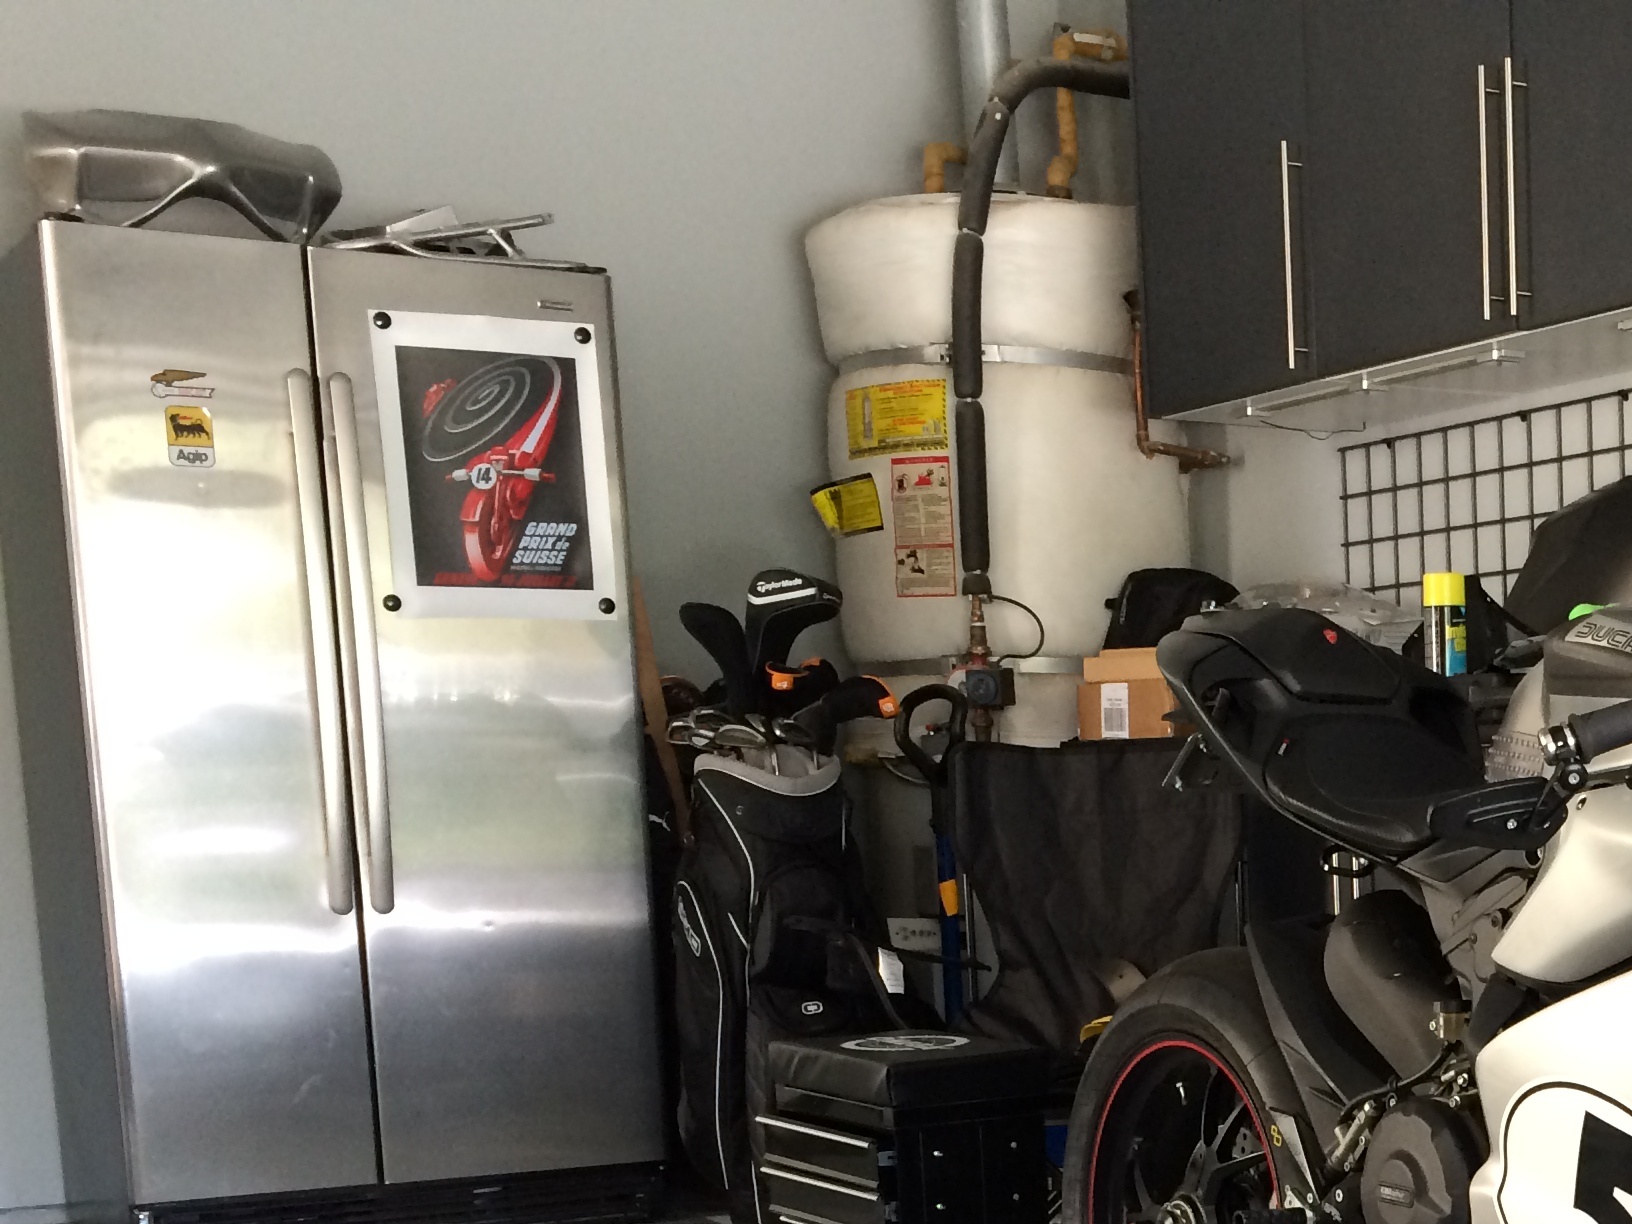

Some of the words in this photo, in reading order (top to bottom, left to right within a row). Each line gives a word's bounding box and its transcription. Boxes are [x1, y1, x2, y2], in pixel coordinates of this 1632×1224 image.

[177, 449, 208, 464] Agip
[476, 467, 493, 484] 14
[525, 521, 577, 536] GRAND
[518, 536, 557, 549] PRIX
[555, 537, 570, 550] de
[512, 550, 567, 564] SUISSE
[756, 578, 803, 593] TaylorMade
